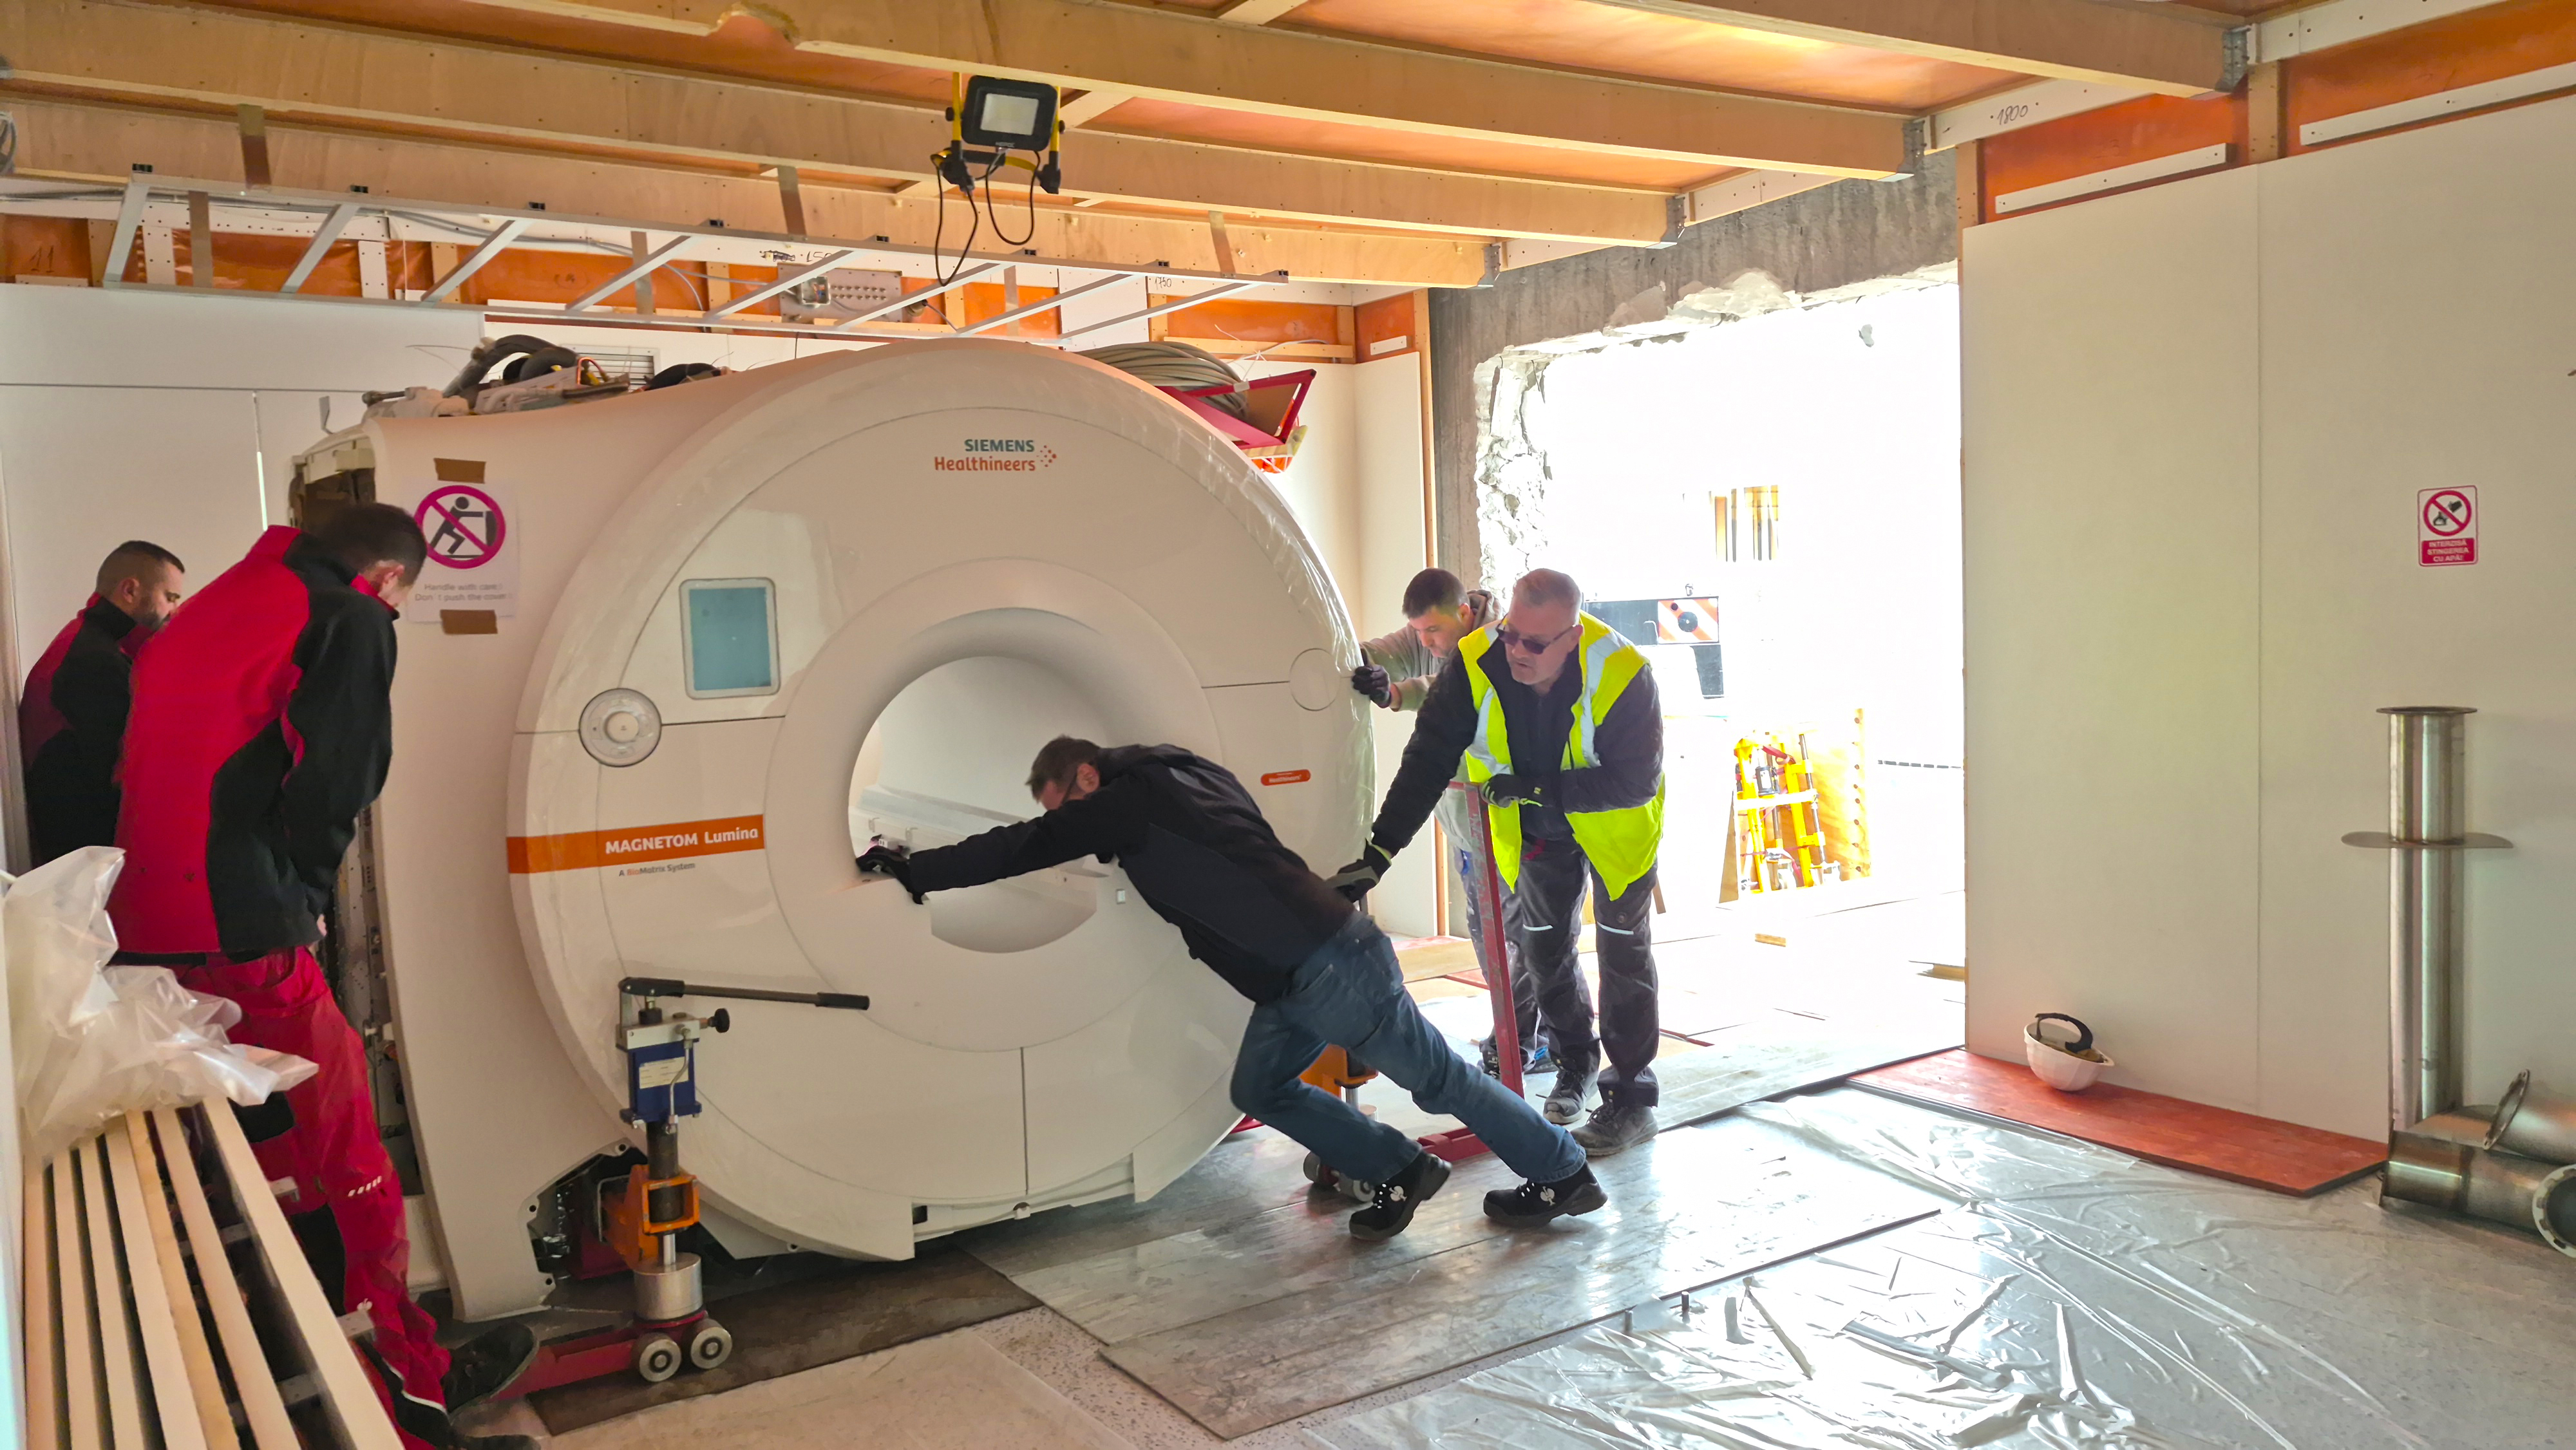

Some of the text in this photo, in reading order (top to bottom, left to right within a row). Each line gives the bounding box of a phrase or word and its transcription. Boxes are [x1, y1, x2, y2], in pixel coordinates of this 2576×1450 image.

[1996, 105, 2029, 126] 1800
[1154, 276, 1172, 290] 1750
[964, 439, 1034, 452] SIEMENS
[934, 456, 1036, 471] Healthineers
[443, 593, 466, 602] push
[605, 827, 759, 855] MAGNETOM Lumina
[627, 865, 666, 876] BioMatrix
[667, 862, 696, 873] System
